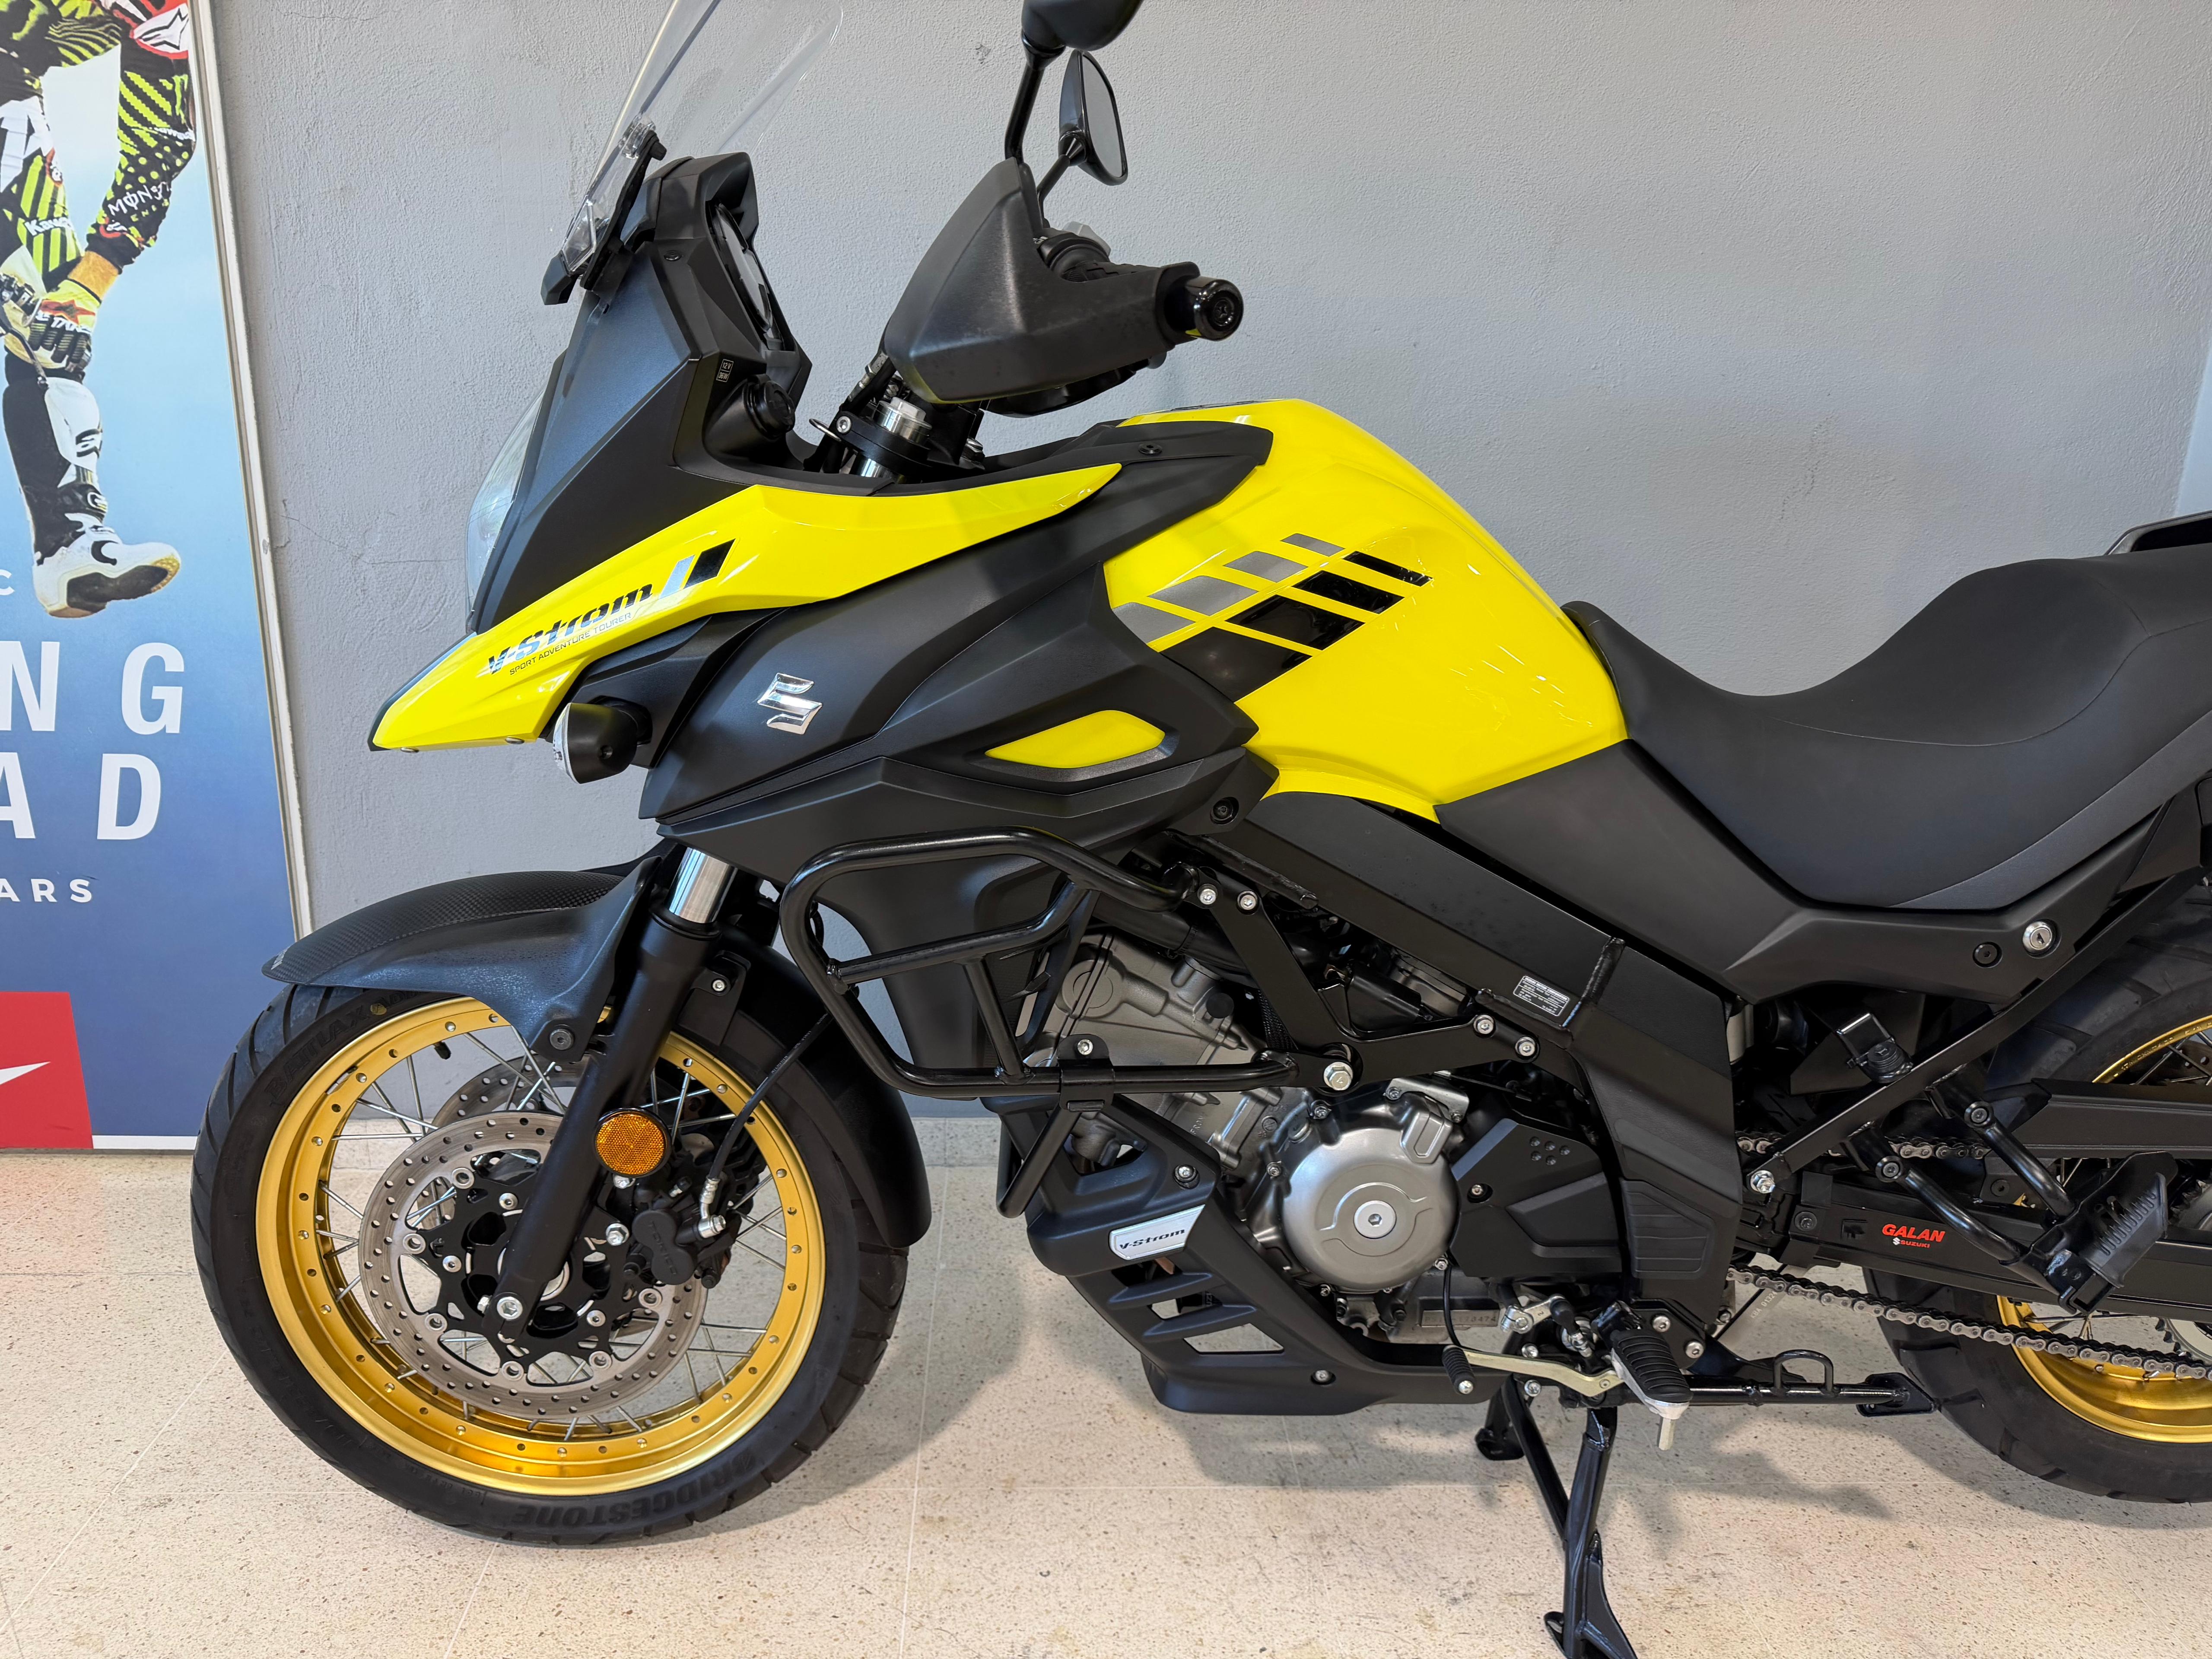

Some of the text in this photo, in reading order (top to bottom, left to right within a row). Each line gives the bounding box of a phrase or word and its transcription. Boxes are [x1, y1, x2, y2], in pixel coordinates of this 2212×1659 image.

[488, 584, 654, 675] V-Strom
[509, 612, 632, 676] SPORT ADVENTURE TOURER
[1119, 1229, 1185, 1249] V-Strom
[1882, 1224, 1946, 1243] GALAN
